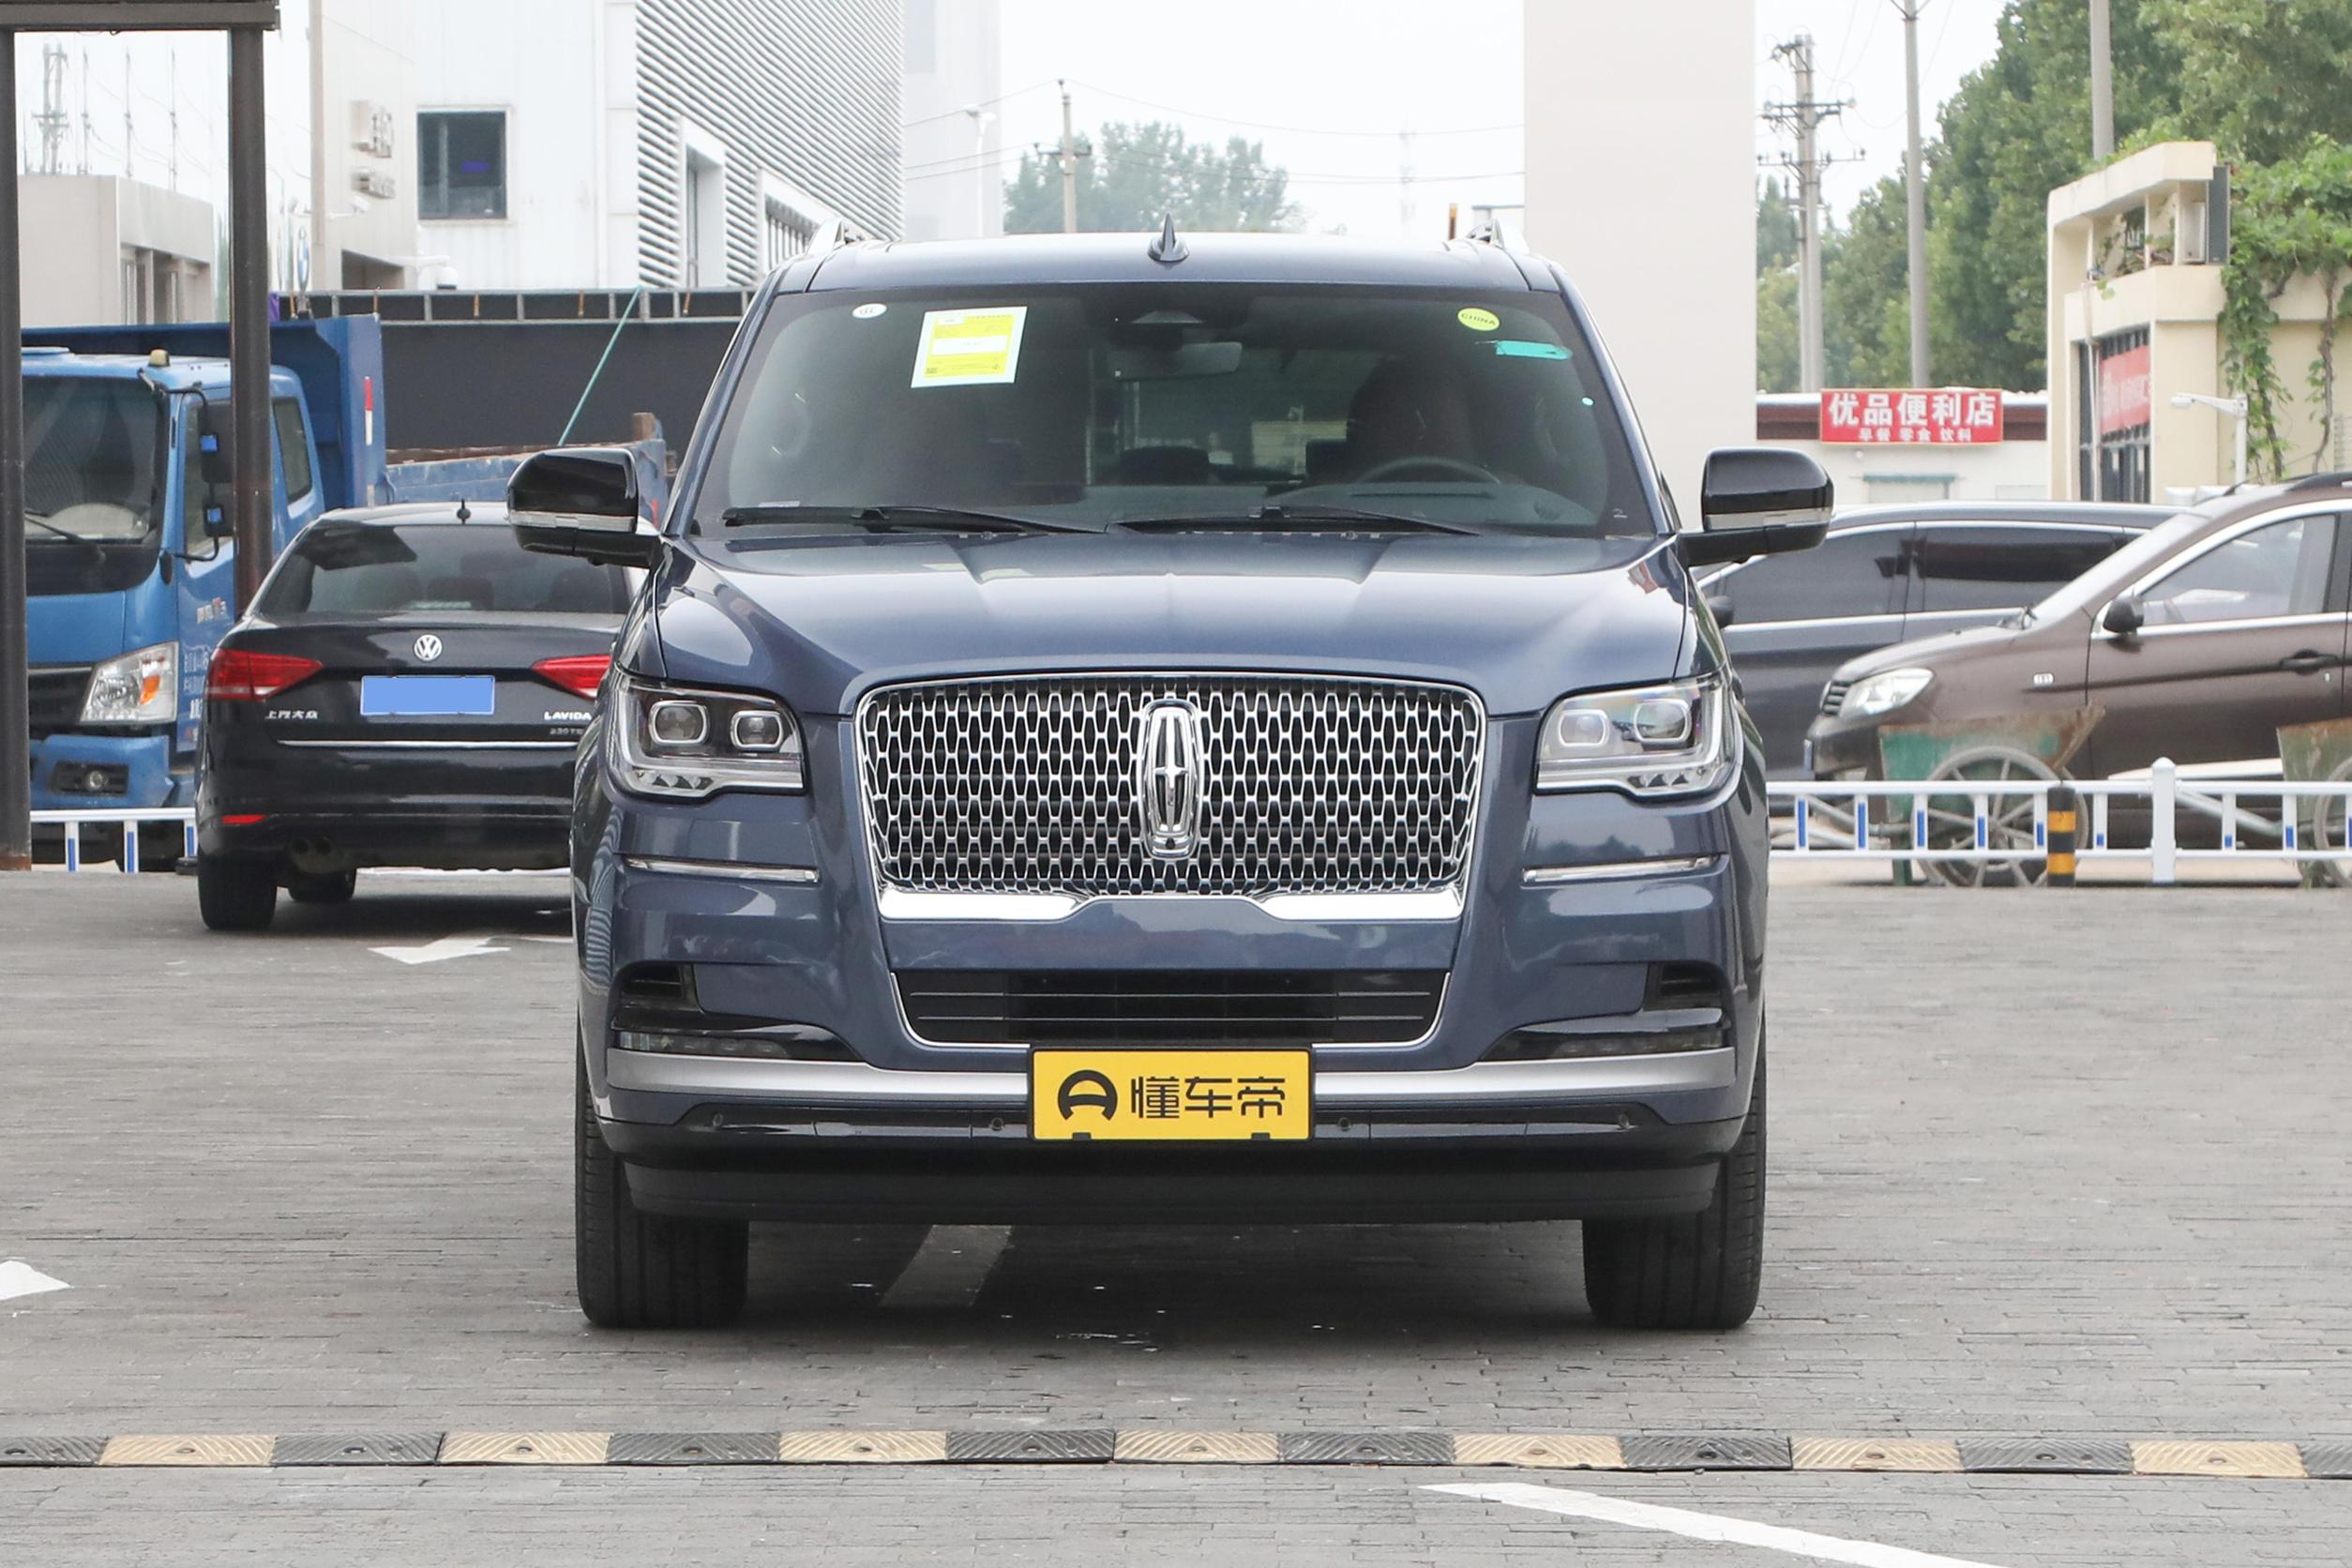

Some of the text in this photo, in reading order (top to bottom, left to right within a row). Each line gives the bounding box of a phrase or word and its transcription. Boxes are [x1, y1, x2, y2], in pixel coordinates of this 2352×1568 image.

[1461, 313, 1496, 325] CHINA
[1829, 392, 1997, 427] 优品便利店
[1899, 428, 1931, 442] 零食
[1939, 428, 1972, 442] 饮料
[544, 711, 592, 720] LAVIDA
[1131, 1076, 1286, 1119] 懂车帝
